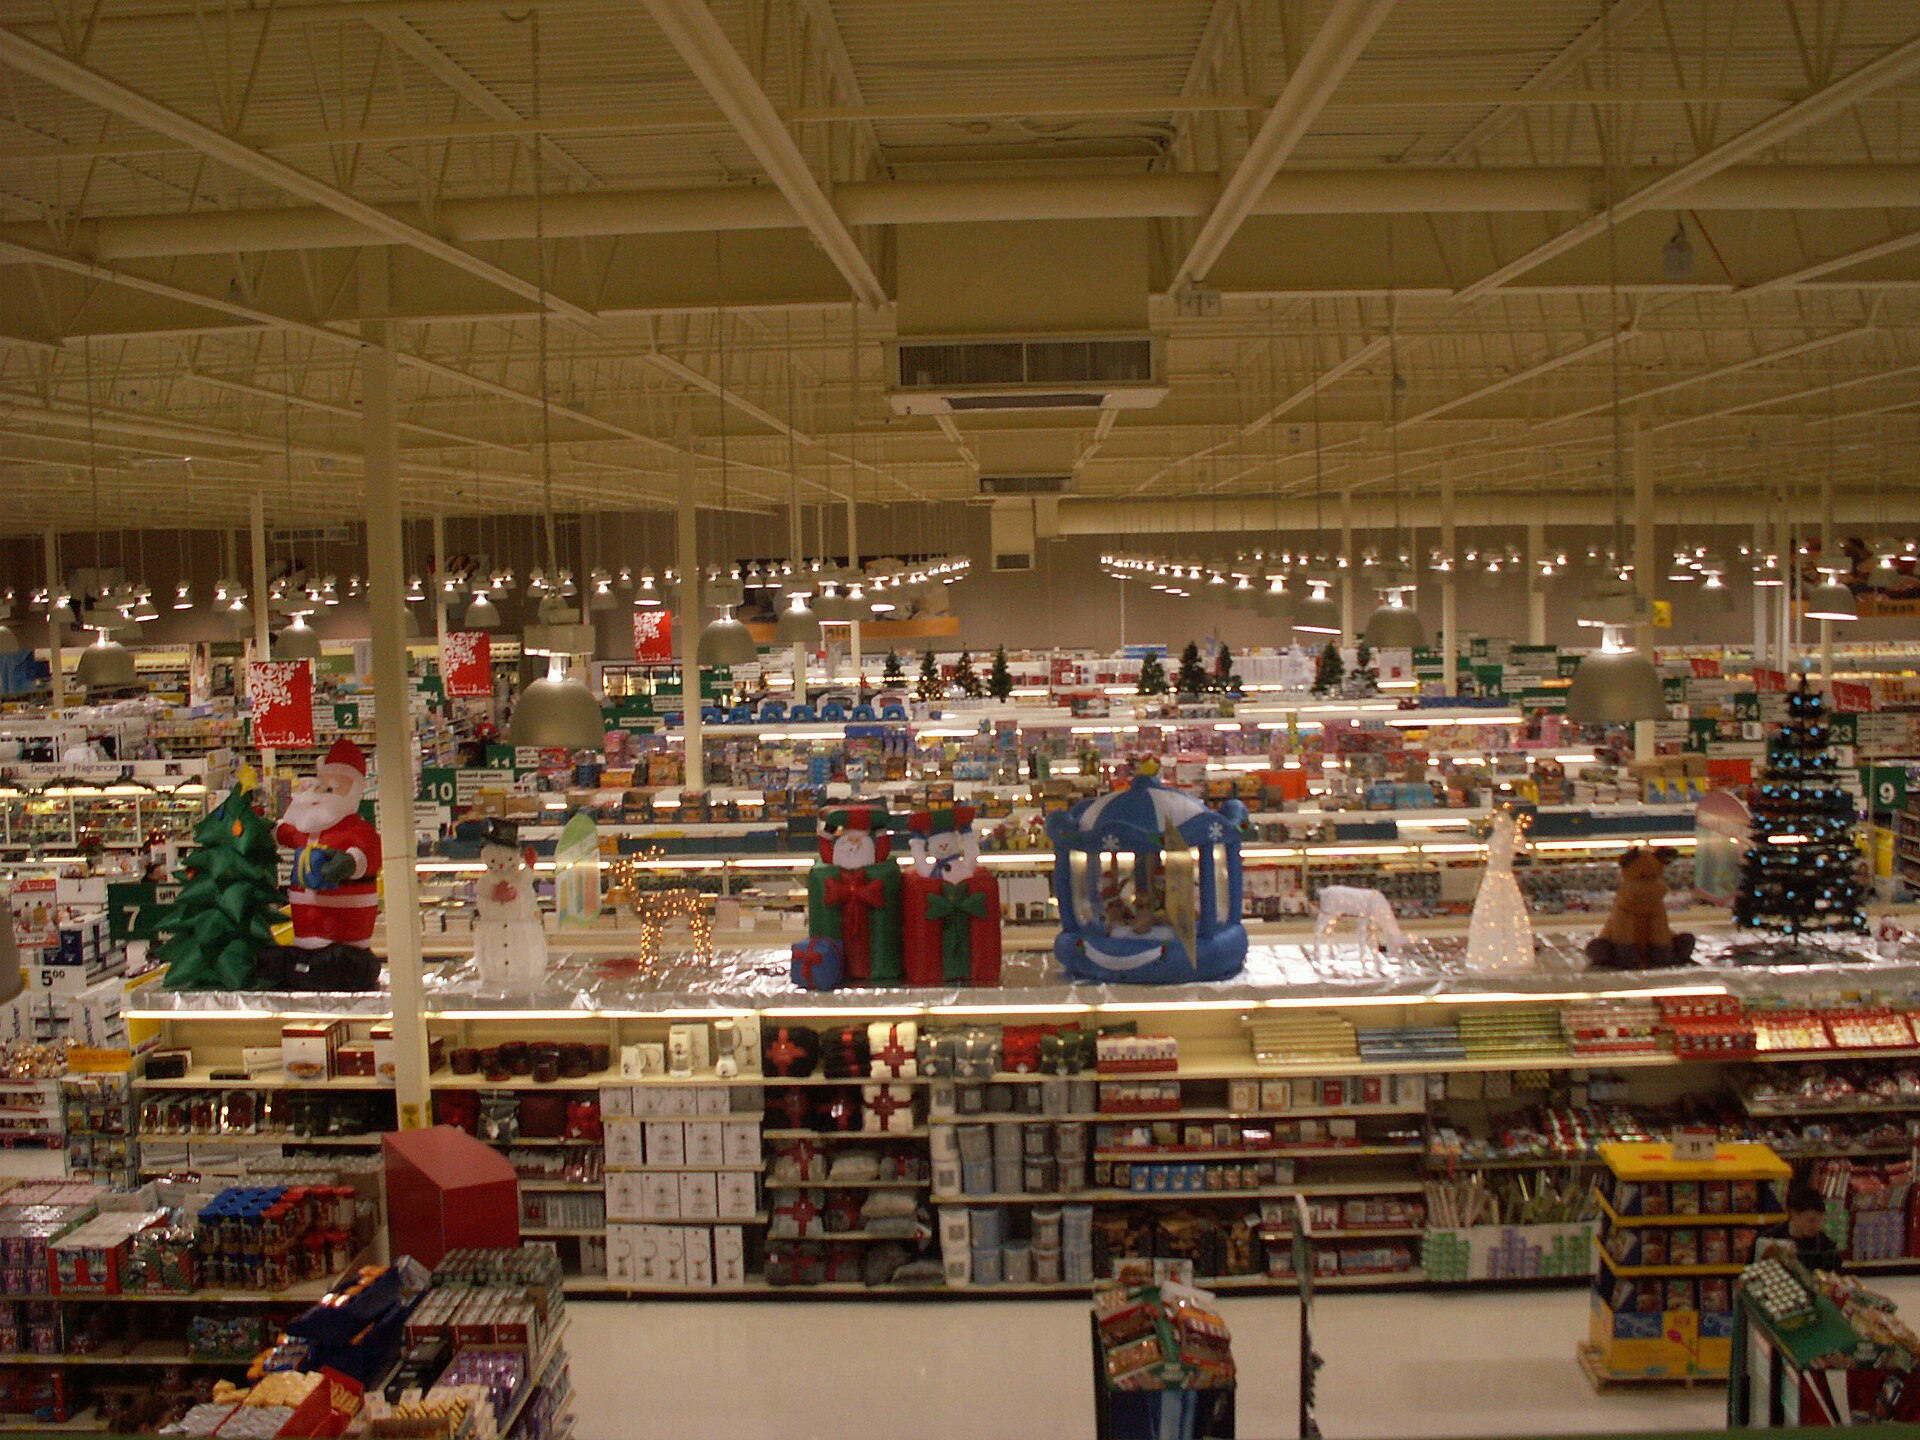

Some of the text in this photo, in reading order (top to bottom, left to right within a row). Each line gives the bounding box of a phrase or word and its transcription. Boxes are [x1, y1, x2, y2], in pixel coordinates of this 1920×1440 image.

[344, 712, 353, 726] 2
[1829, 724, 1853, 742] 23
[31, 763, 120, 775] Designer Fragrances
[427, 782, 453, 802] 10
[1878, 781, 1895, 805] 9
[159, 889, 176, 900] gift
[123, 906, 140, 933] 7
